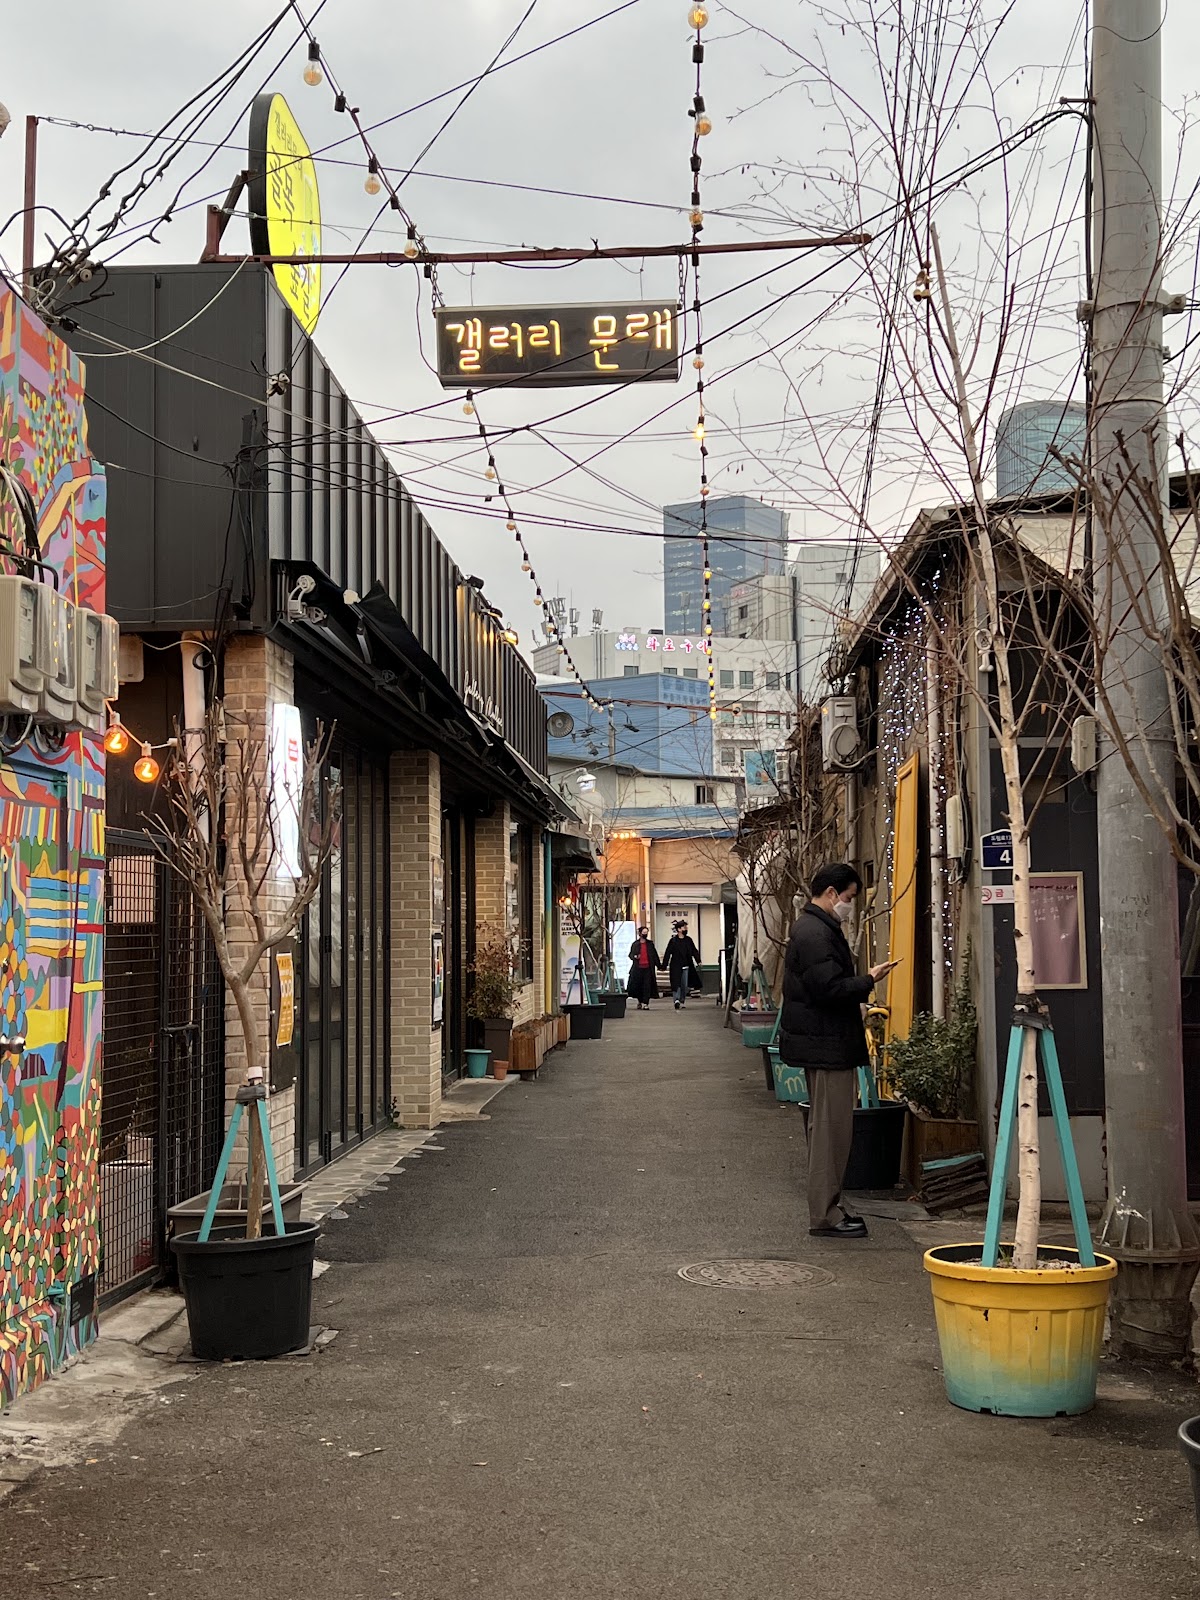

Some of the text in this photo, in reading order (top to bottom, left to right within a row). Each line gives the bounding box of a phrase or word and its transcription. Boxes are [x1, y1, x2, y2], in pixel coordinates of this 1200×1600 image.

[270, 144, 295, 232] 골목
[446, 308, 672, 371] 갤러리 문래
[1000, 849, 1011, 864] 4
